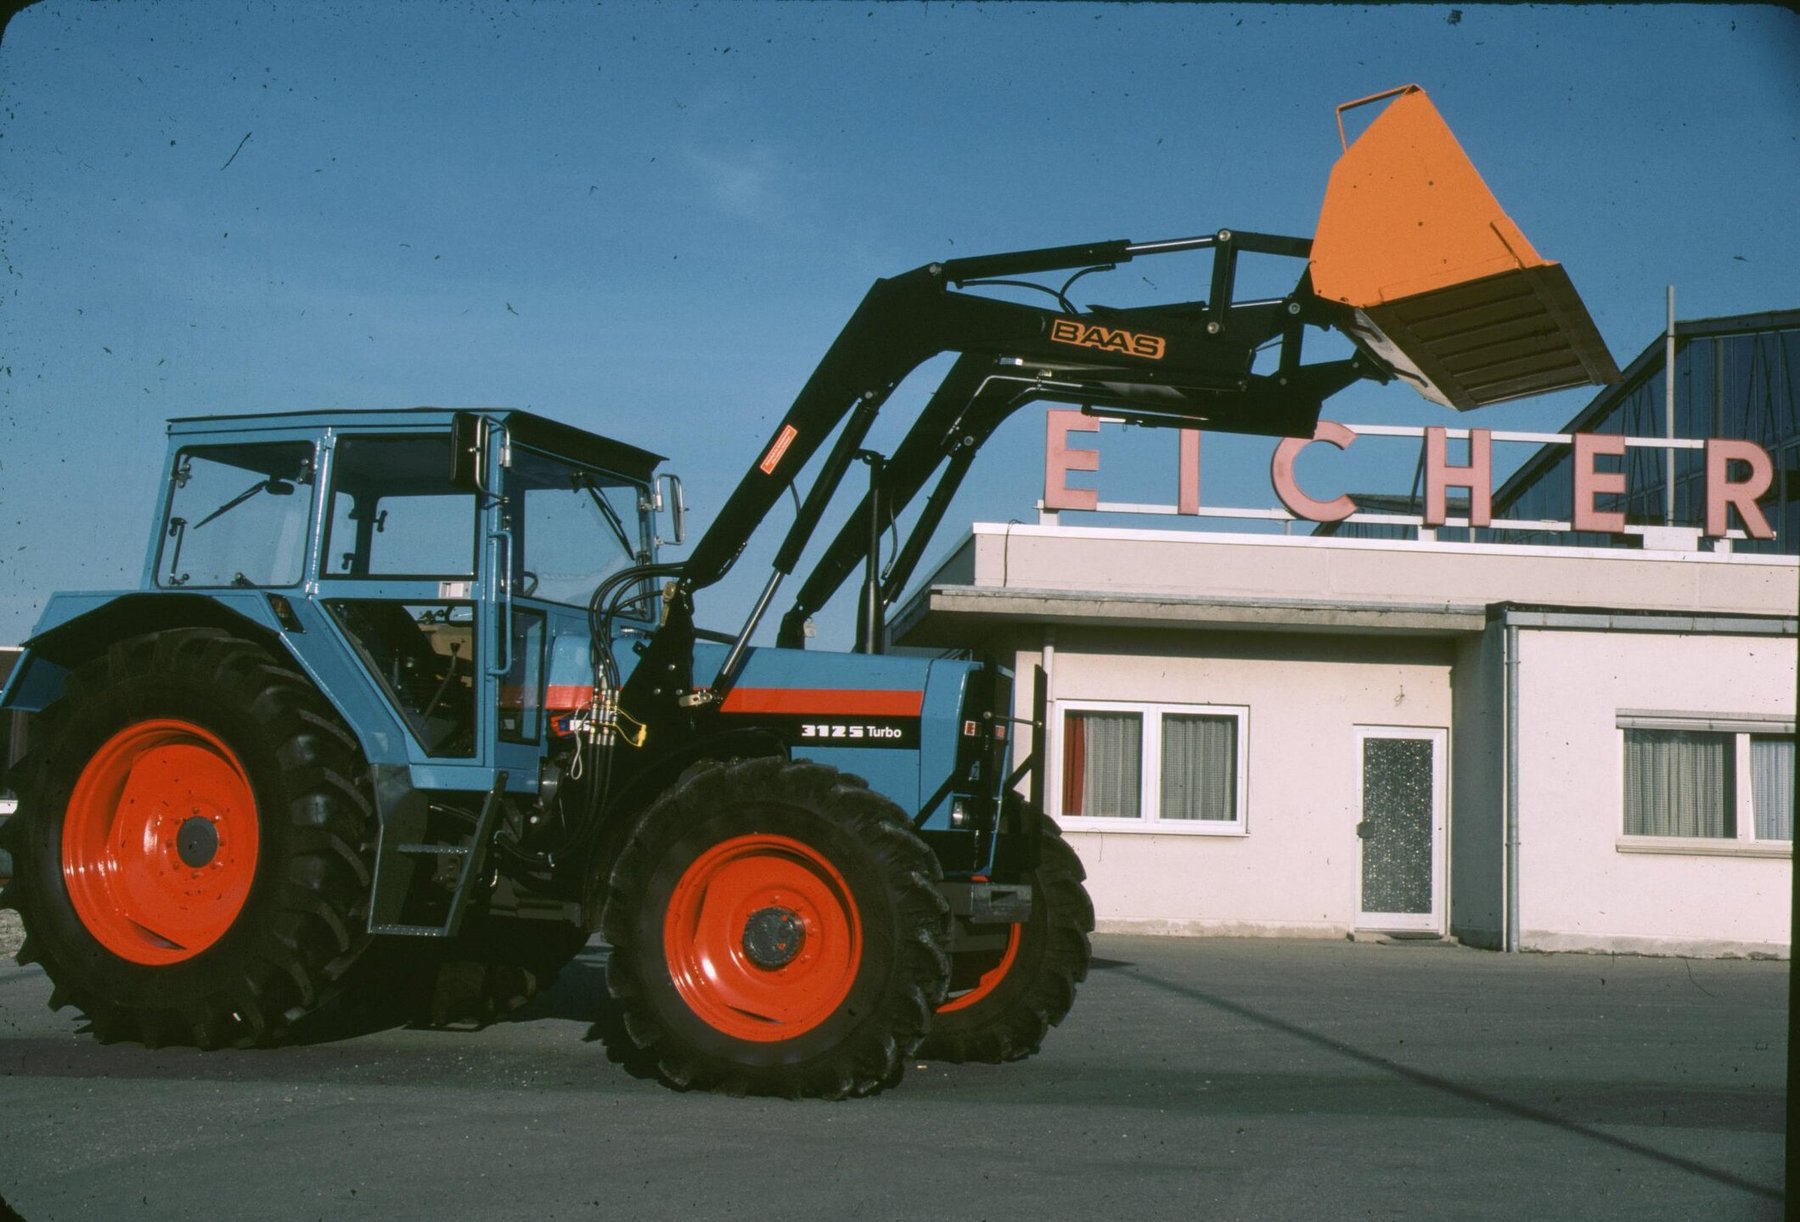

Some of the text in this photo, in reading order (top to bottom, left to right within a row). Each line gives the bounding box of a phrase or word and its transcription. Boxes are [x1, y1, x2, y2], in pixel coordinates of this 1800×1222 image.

[1051, 320, 1164, 359] BAAS
[1044, 409, 1776, 540] EICHER
[801, 724, 902, 738] 3125 Turbo
